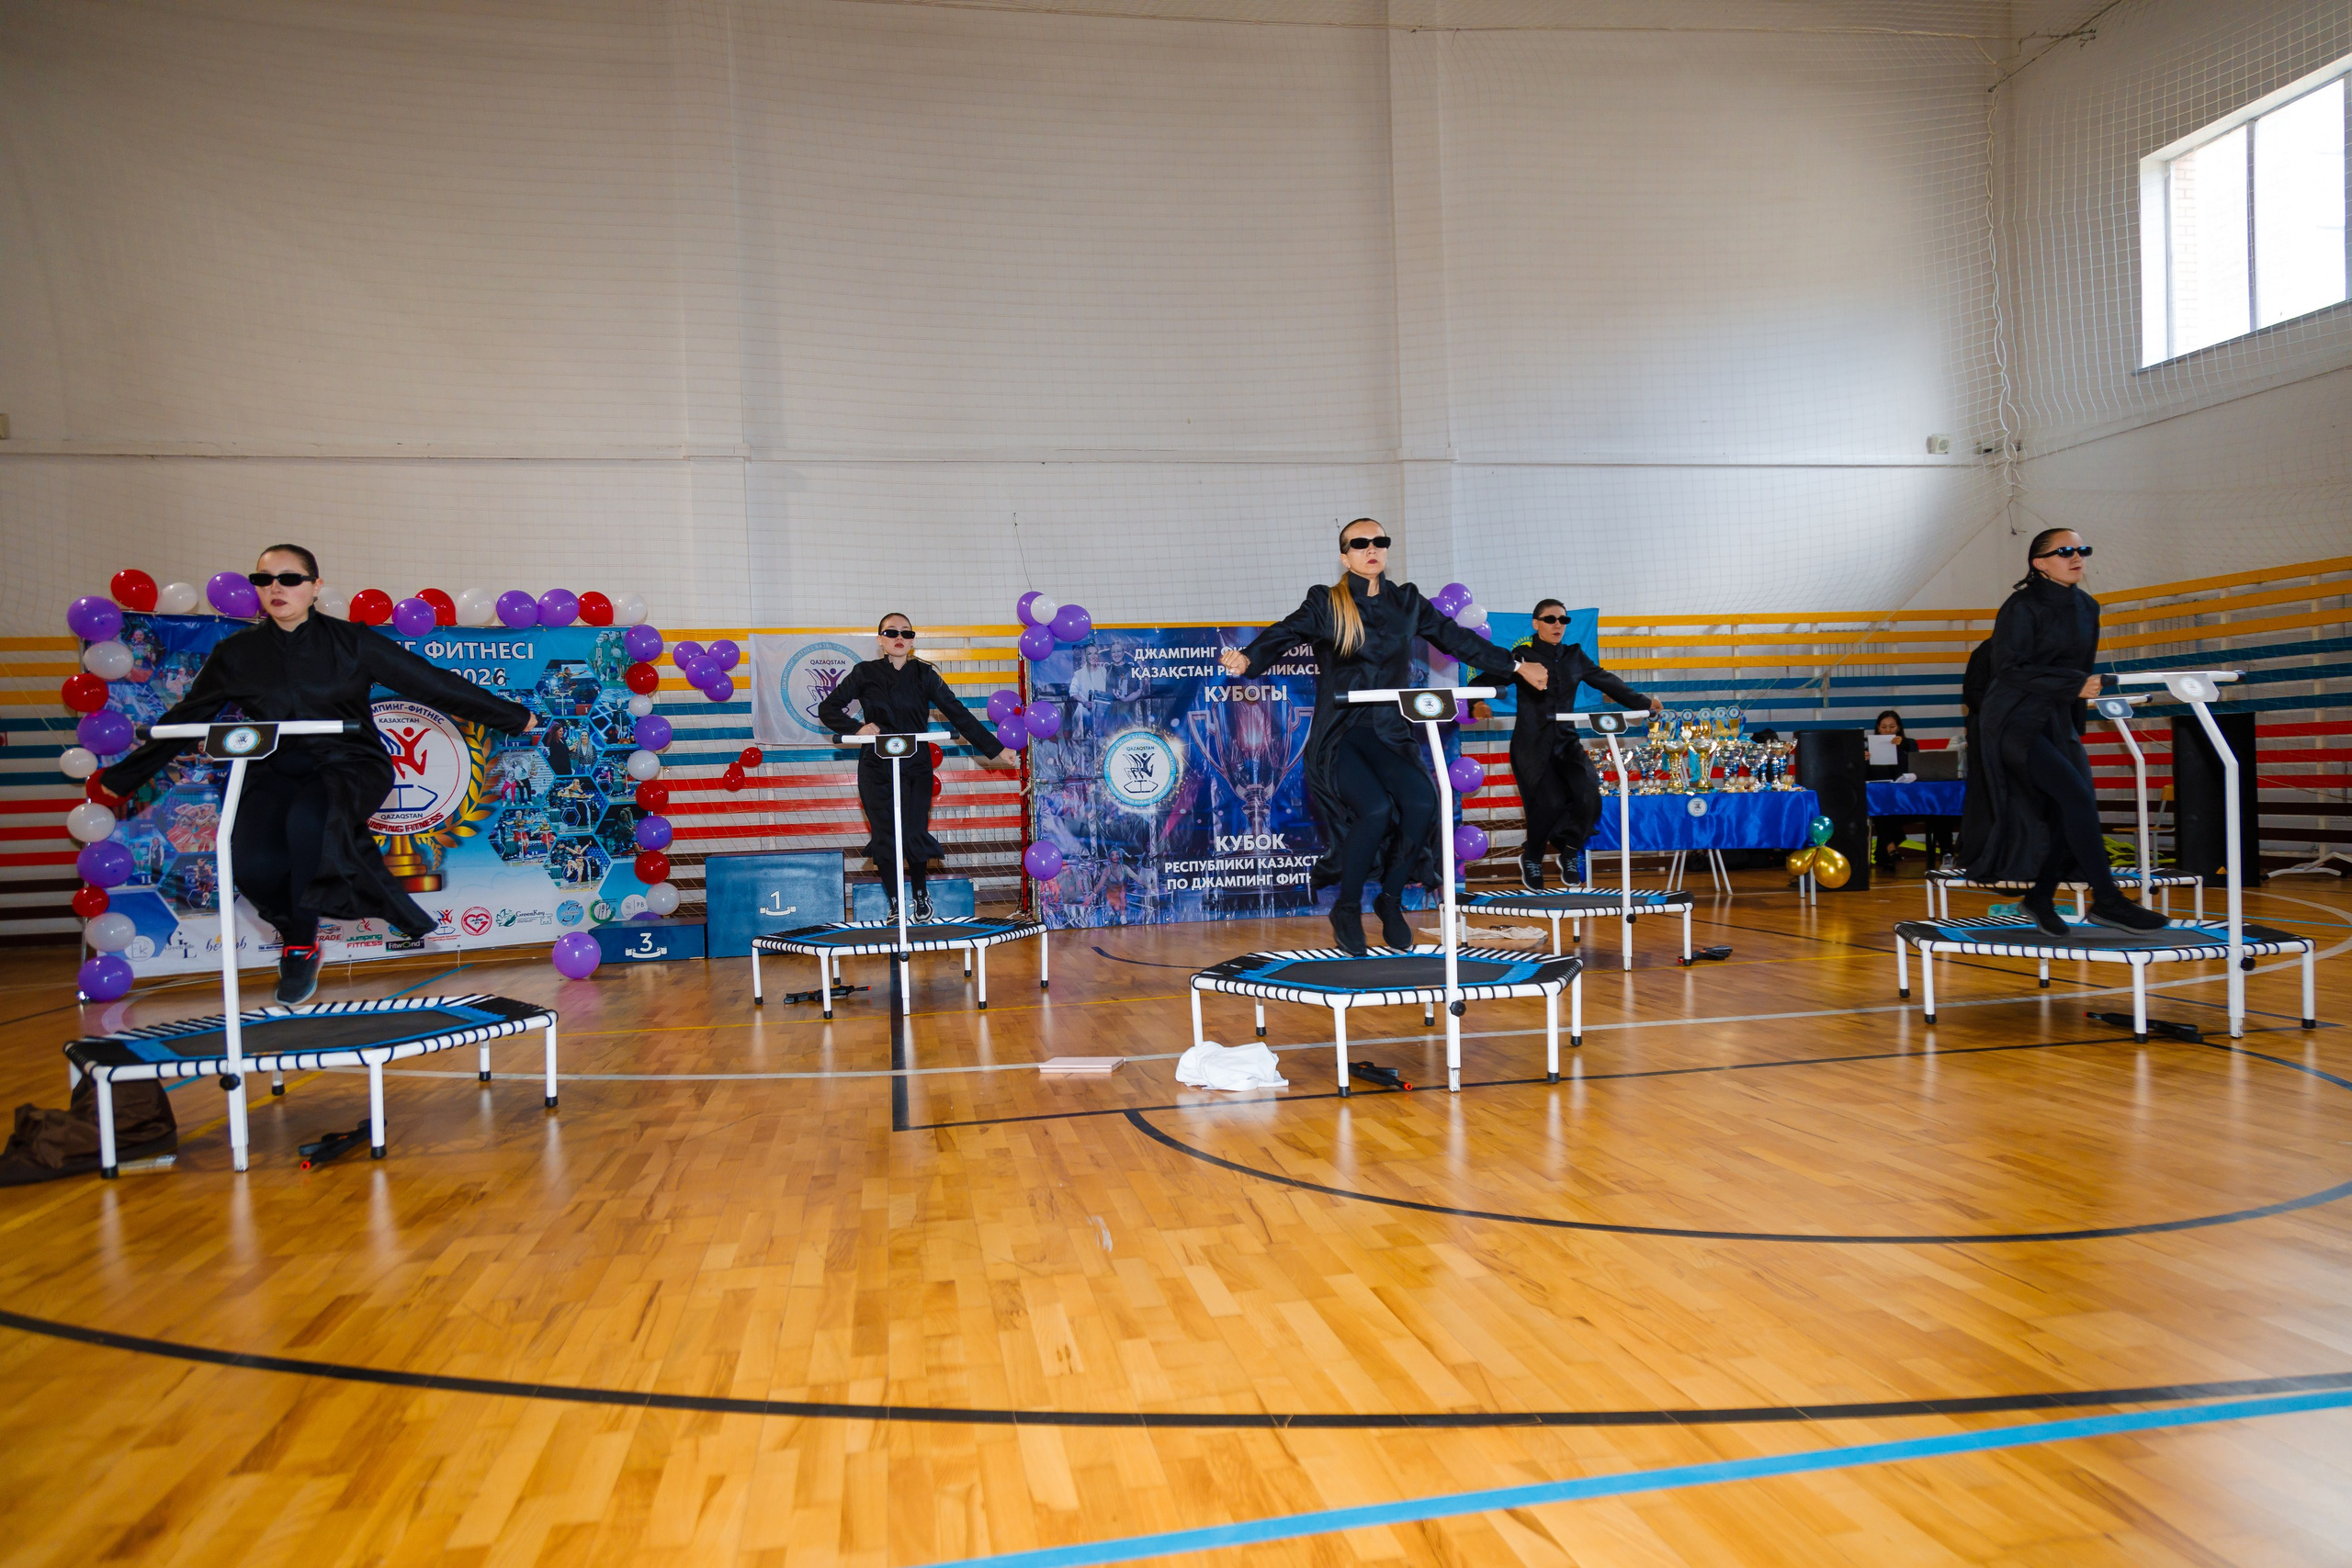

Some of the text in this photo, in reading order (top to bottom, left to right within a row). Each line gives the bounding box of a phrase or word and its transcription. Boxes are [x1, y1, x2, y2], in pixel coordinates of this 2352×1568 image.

[424, 641, 534, 660] ФИТНЕСІ
[1134, 647, 1217, 661] ДЖАМПИНГ
[1131, 664, 1321, 680] ҚАЗАҚСТАН РЕЛИКАС
[1204, 685, 1287, 703] КУБОГЫ
[372, 704, 445, 725] МПИНГ-ФИТНЕС
[368, 812, 445, 832] UMPING FITNESS
[1216, 833, 1286, 852] КУБОК
[1164, 855, 1324, 873] РЕСПУБЛИКИ КАЗАХСТ
[1167, 873, 1311, 891] ПО ДЖАМПИНГ ФИТН
[770, 890, 780, 909] 1
[639, 932, 653, 953] 3
